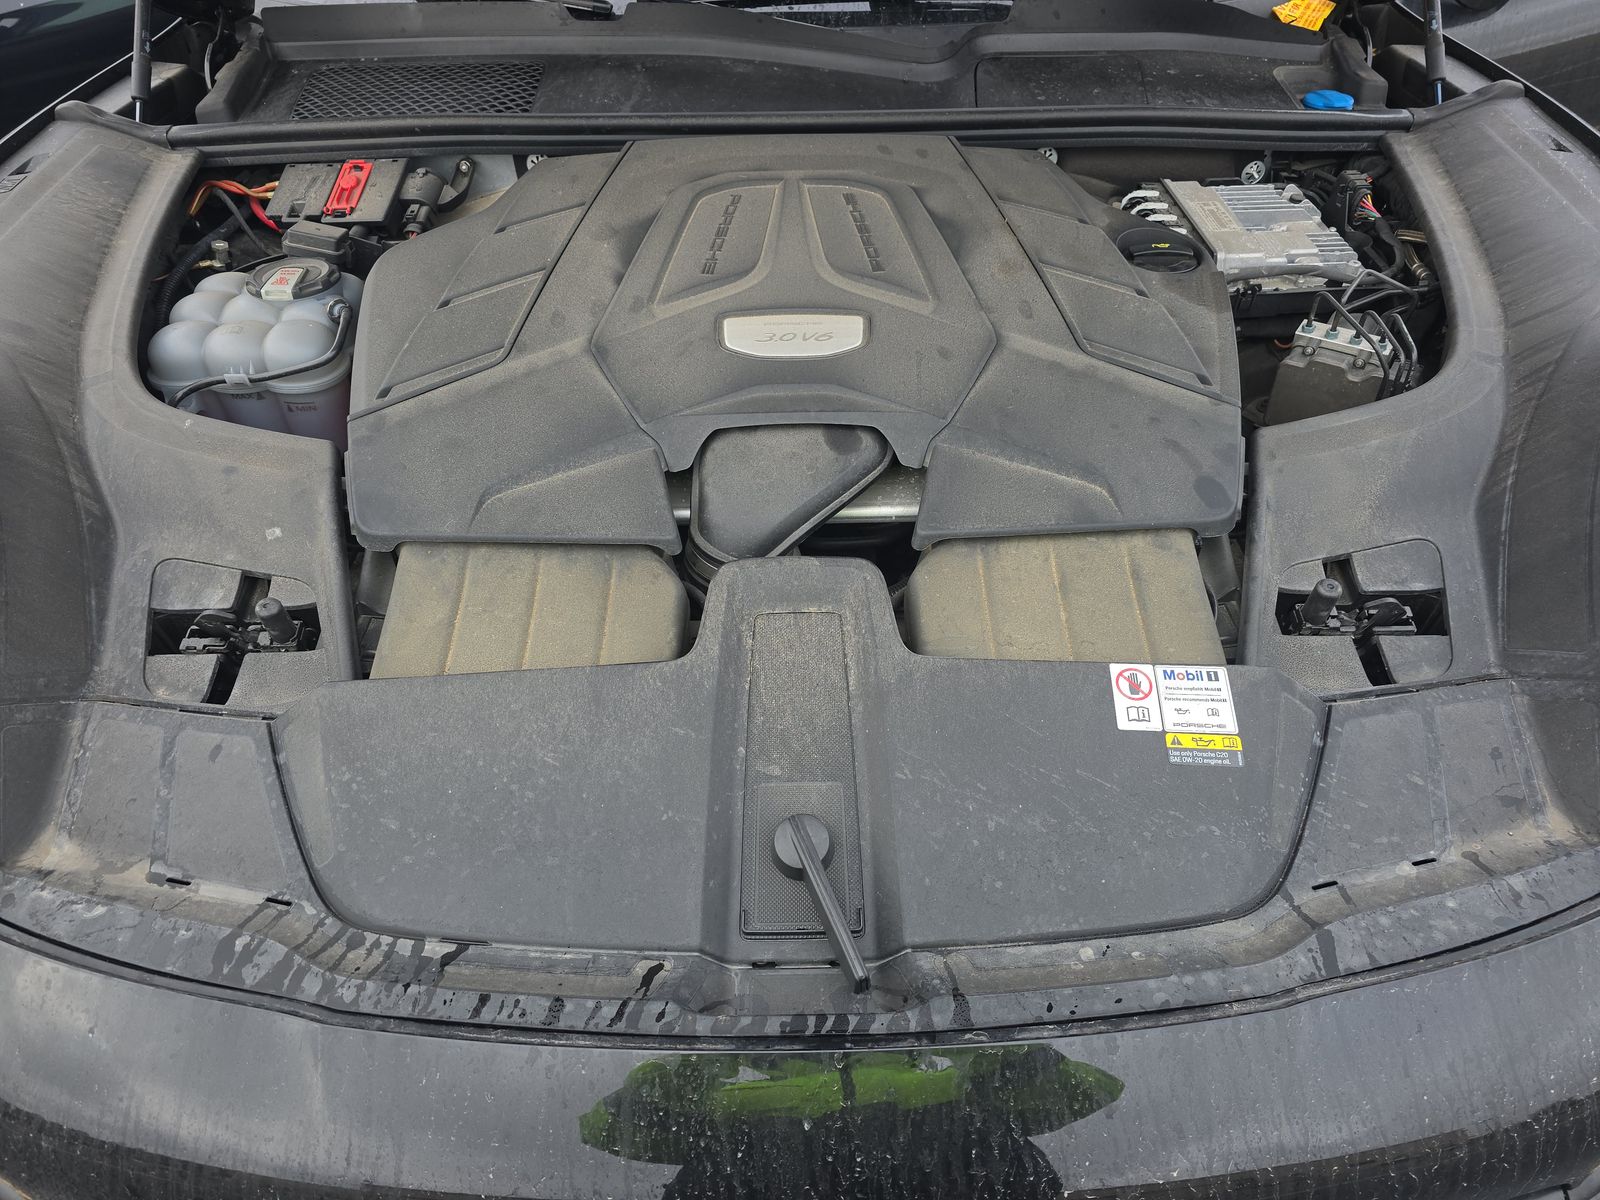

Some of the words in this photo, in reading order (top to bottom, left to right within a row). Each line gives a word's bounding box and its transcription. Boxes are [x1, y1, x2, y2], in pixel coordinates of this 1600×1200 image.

[701, 194, 742, 275] PORSCHE
[842, 192, 886, 273] PORSCHE
[754, 332, 797, 343] 3.0
[802, 332, 834, 342] V6
[1163, 669, 1204, 681] Mobil
